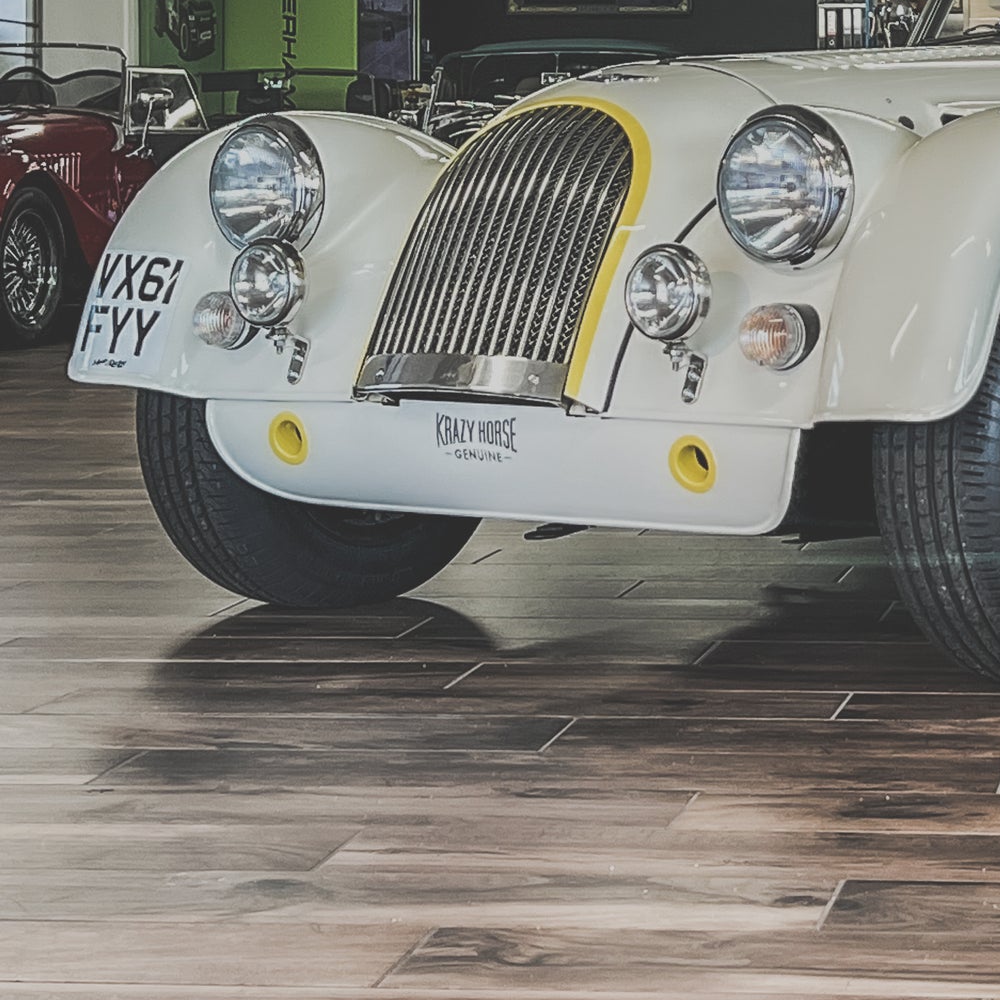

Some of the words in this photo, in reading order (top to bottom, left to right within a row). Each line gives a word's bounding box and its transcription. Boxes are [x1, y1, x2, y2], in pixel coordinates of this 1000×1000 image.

[96, 253, 184, 304] VX61
[80, 304, 161, 357] FYY
[436, 412, 475, 448] KRAZY
[478, 416, 518, 453] HORSE
